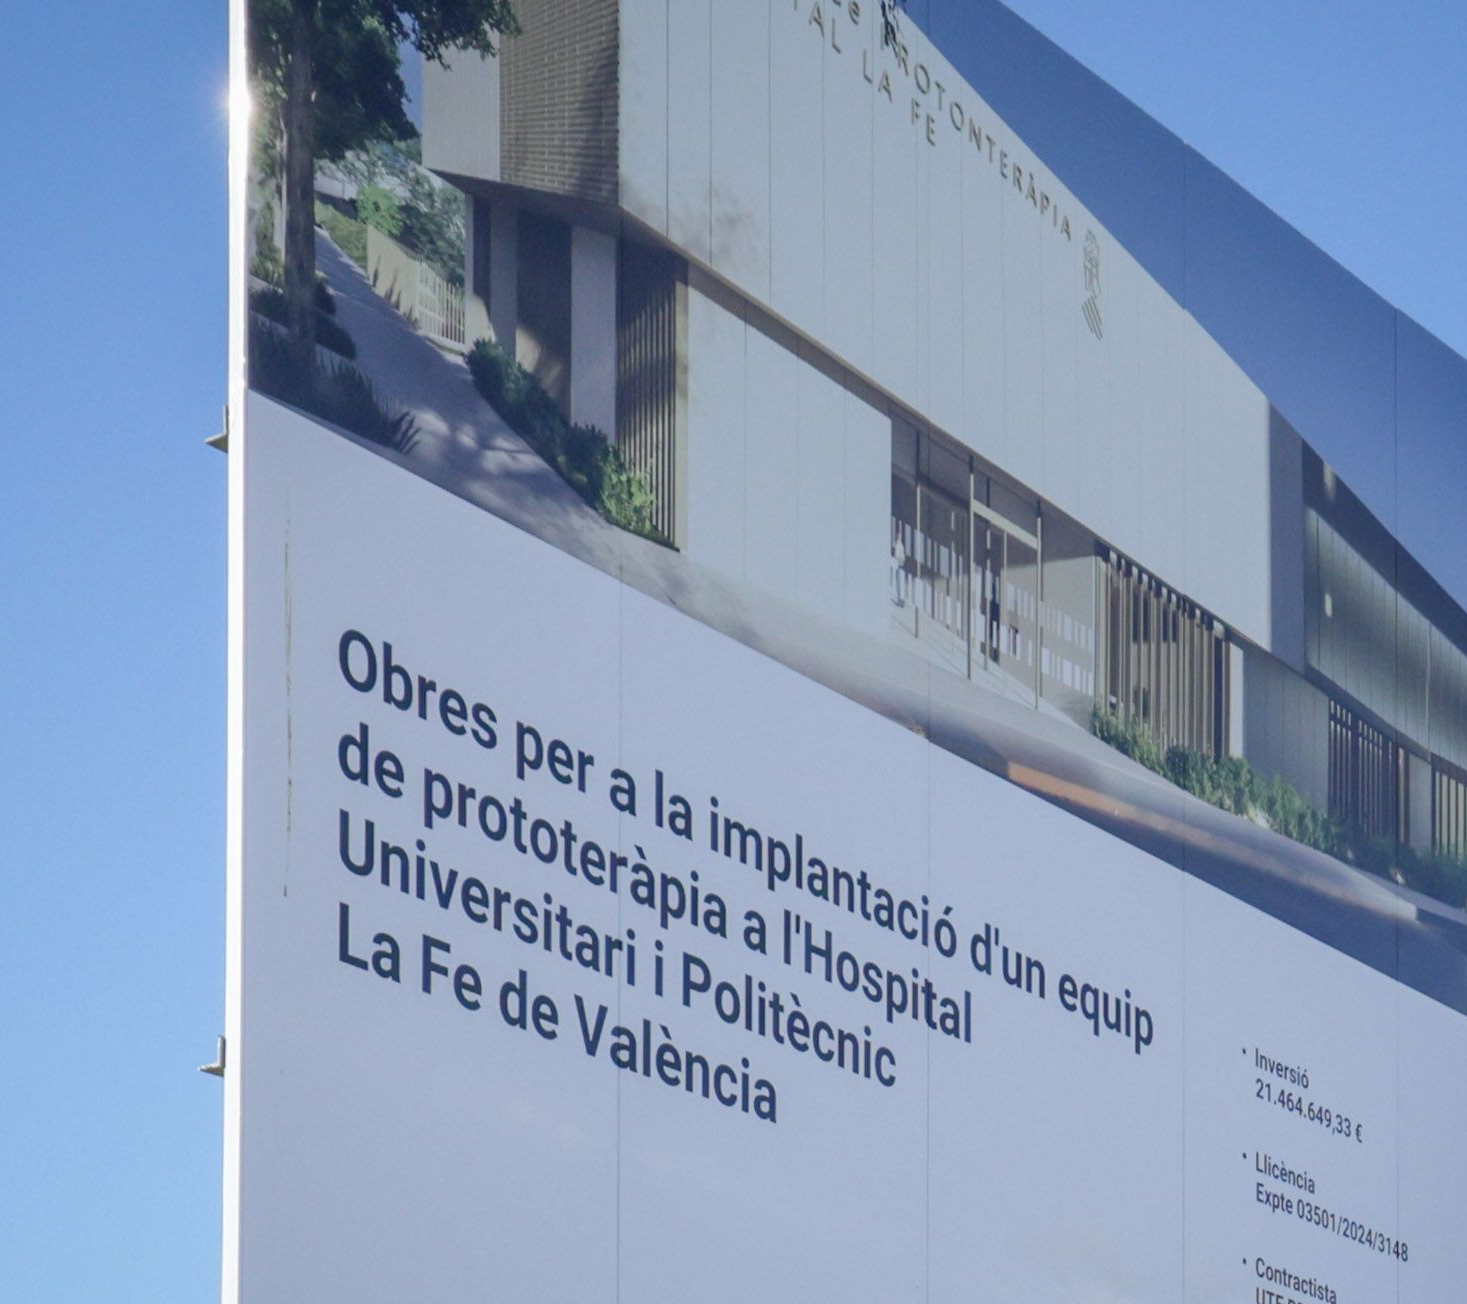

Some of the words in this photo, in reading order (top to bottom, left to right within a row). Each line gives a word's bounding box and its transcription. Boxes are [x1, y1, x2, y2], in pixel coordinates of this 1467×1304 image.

[861, 48, 893, 104] LA
[911, 97, 936, 147] FE
[337, 628, 499, 751] Obres
[515, 720, 596, 794] per
[608, 767, 638, 818] a
[654, 768, 694, 842] la
[709, 795, 958, 959] implantació
[969, 922, 1047, 1000] d'un
[1057, 972, 1155, 1056] equip
[337, 720, 406, 800] de
[422, 766, 729, 940] prototeràpia
[742, 909, 768, 957] a
[782, 908, 973, 1045] l'Hospital
[338, 807, 637, 988] Universitari
[653, 938, 665, 998] i
[681, 950, 897, 1088] Politècnic
[337, 900, 402, 985] La
[420, 932, 484, 1012] Fe
[498, 968, 560, 1042] de
[572, 993, 778, 1125] València
[1254, 1047, 1310, 1090] Inversió
[1255, 1077, 1352, 1139] 21.464.649,33
[1354, 1123, 1364, 1144] €
[1255, 1150, 1316, 1195] Llicència
[1255, 1181, 1294, 1215] Expte
[1296, 1198, 1410, 1263] 03501/2024/3148
